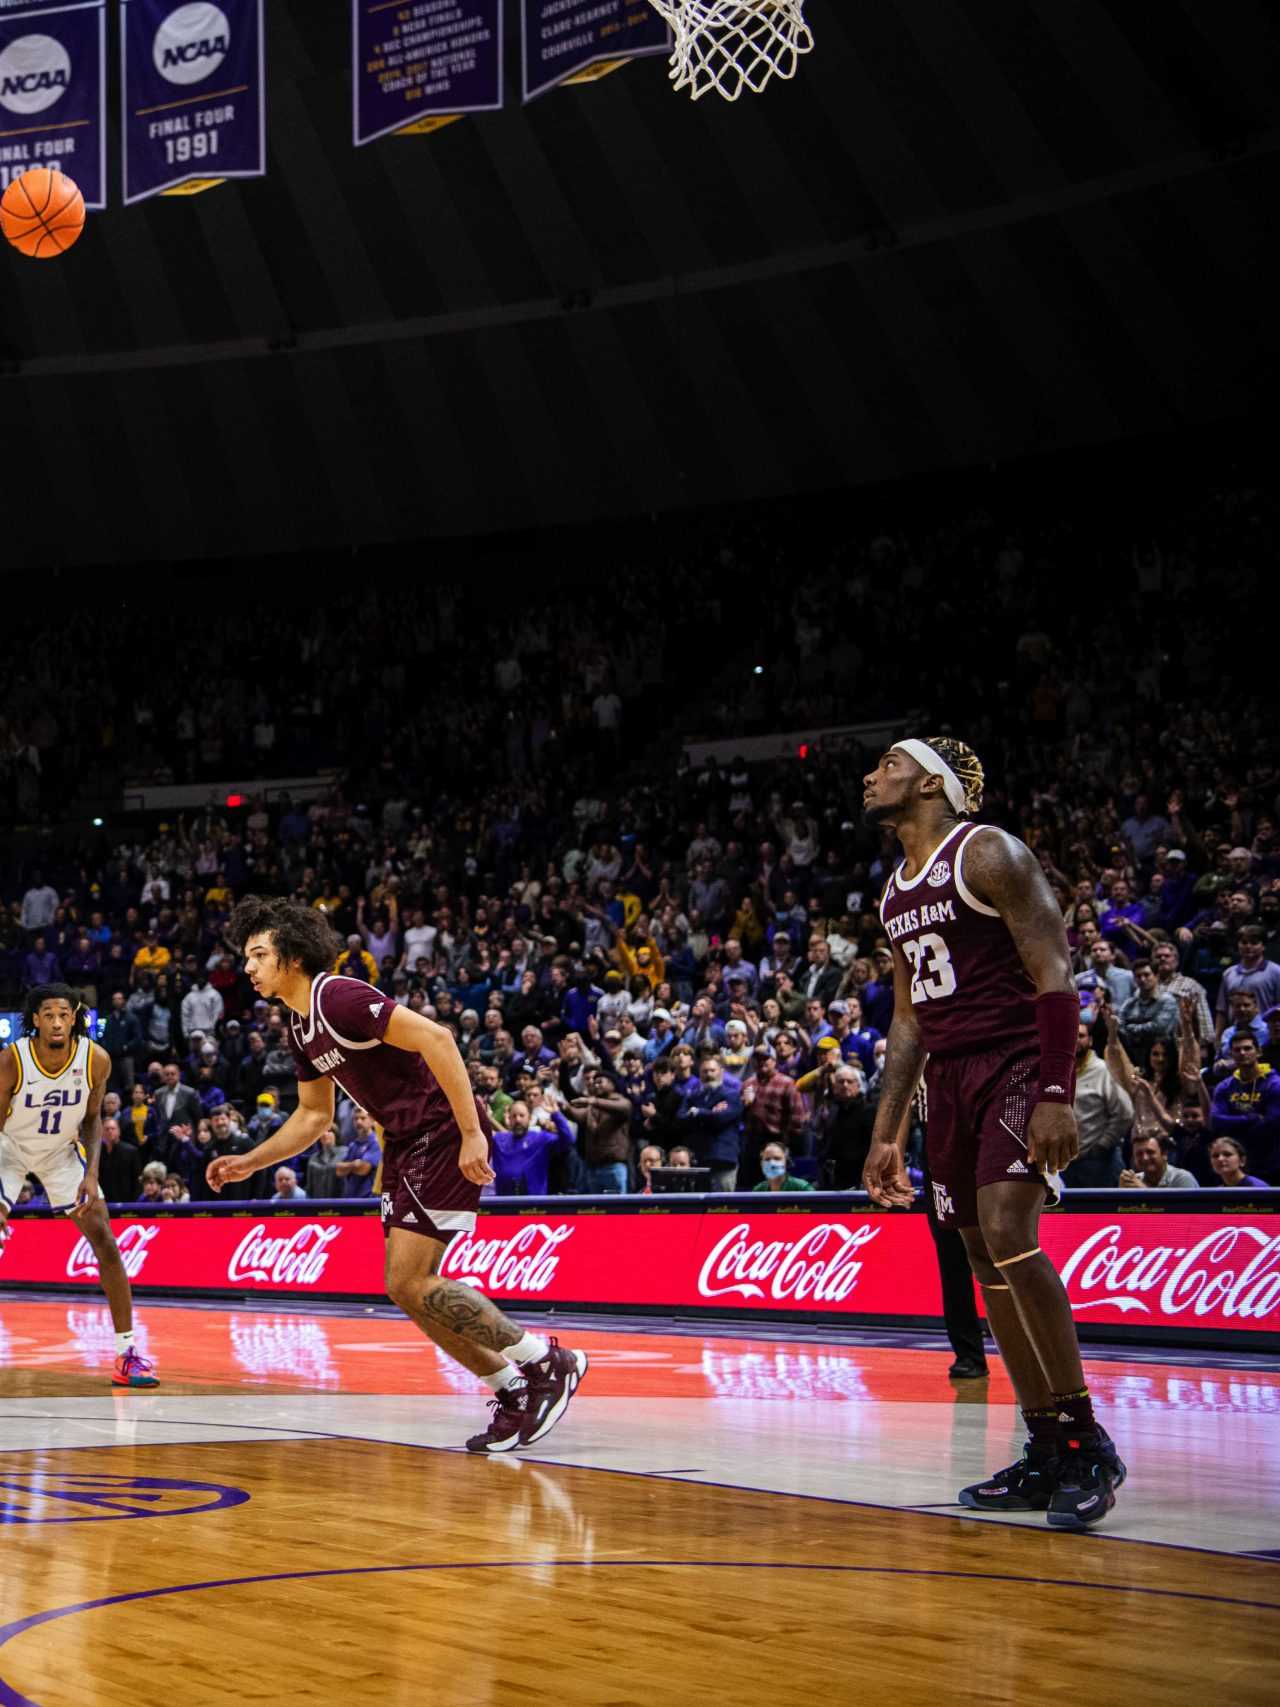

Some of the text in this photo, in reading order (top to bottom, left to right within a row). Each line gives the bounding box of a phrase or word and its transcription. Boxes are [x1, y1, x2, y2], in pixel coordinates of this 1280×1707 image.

[163, 35, 229, 68] NCAA
[1, 68, 68, 96] NCAA
[148, 104, 235, 140] FINAL FOUR
[34, 137, 76, 158] FOUR
[165, 128, 219, 164] 1991
[884, 900, 957, 941] TEXAS A&M
[902, 932, 957, 1004] 23
[25, 1089, 81, 1107] LSU
[38, 1110, 61, 1134] 11
[227, 1224, 342, 1284] Coca-Cola
[698, 1223, 881, 1302] Coca-Cola
